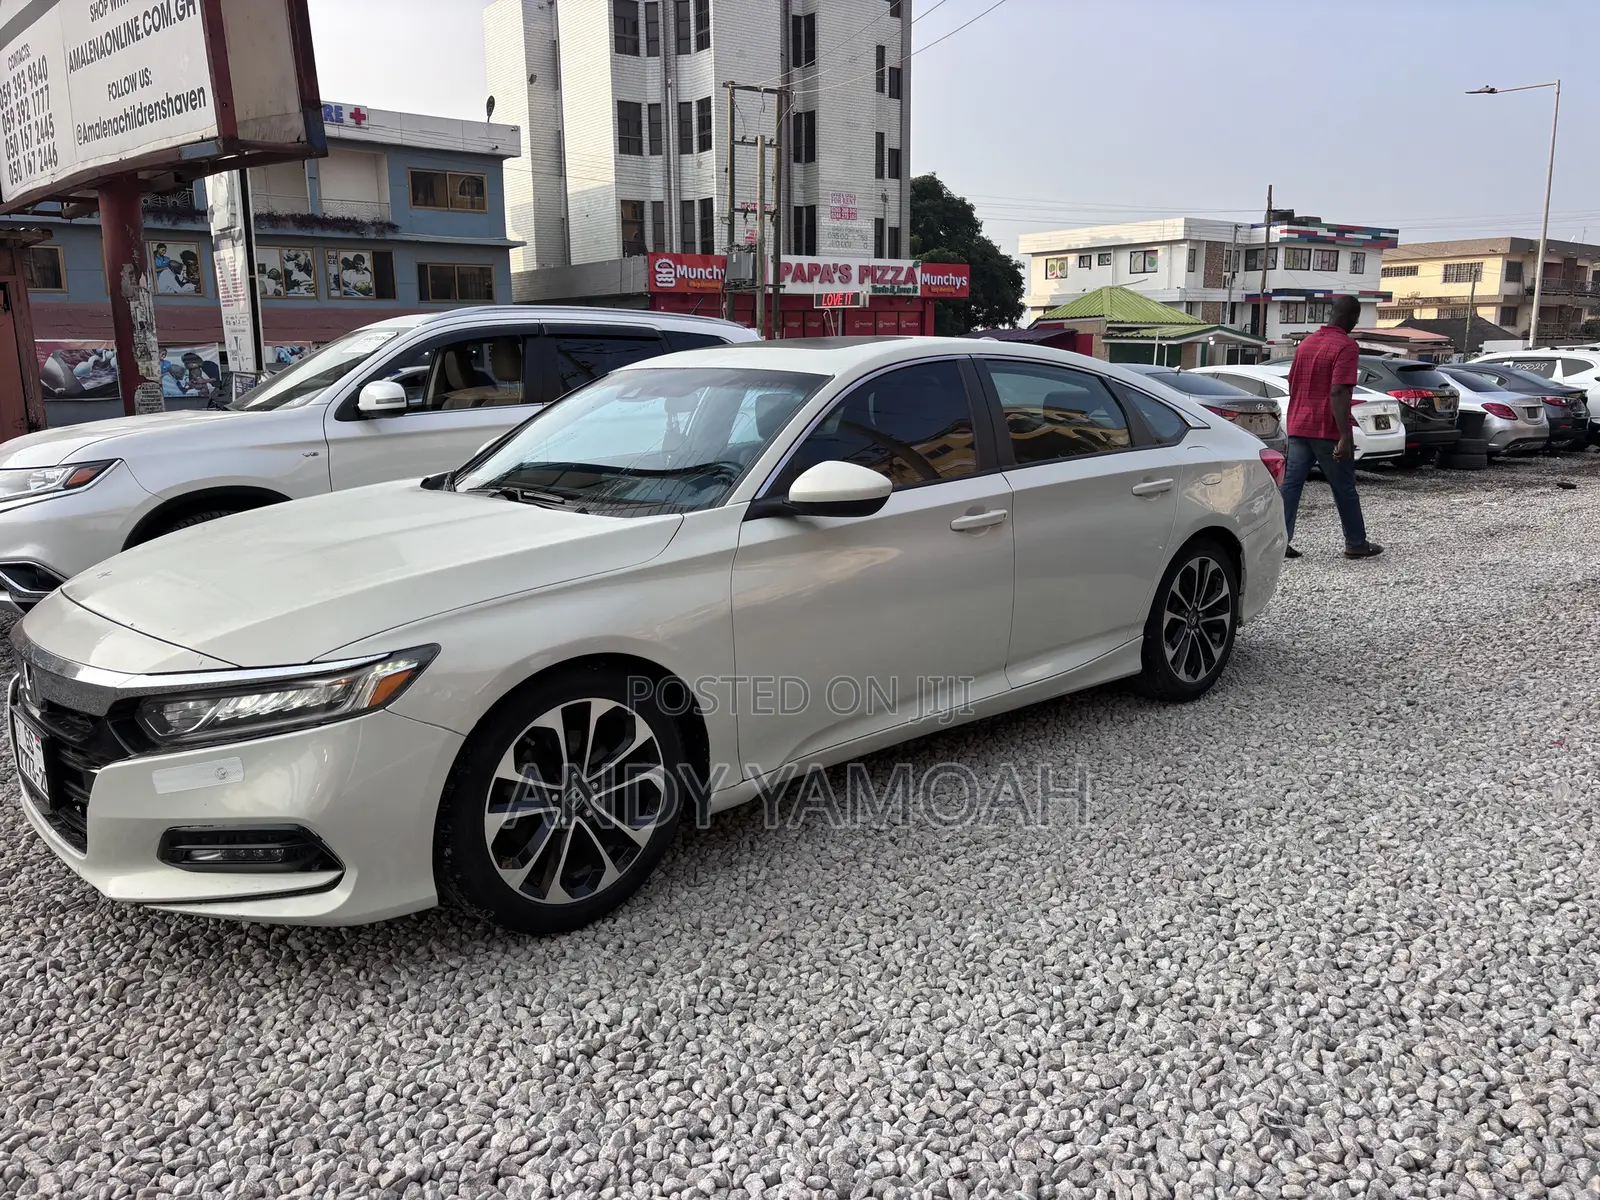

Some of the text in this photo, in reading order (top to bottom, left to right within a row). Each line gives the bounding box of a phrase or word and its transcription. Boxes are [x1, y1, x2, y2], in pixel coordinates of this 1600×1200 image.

[89, 0, 108, 22] SHOP
[68, 0, 197, 74] AMALENAONLINE.COM.GH
[12, 69, 27, 100] 393
[27, 54, 48, 90] 9840
[108, 67, 153, 101] FOLLOW US:
[1, 83, 50, 136] 059 392 1777
[76, 86, 207, 146] @Amalenachildrenshaven
[5, 112, 55, 161] 050 167 2445
[8, 141, 58, 186] 050 167 2446
[676, 264, 725, 280] Munch
[780, 262, 918, 285] PAPA'S PIZZA
[921, 273, 968, 290] Munchys
[821, 292, 854, 306] LOVE IT
